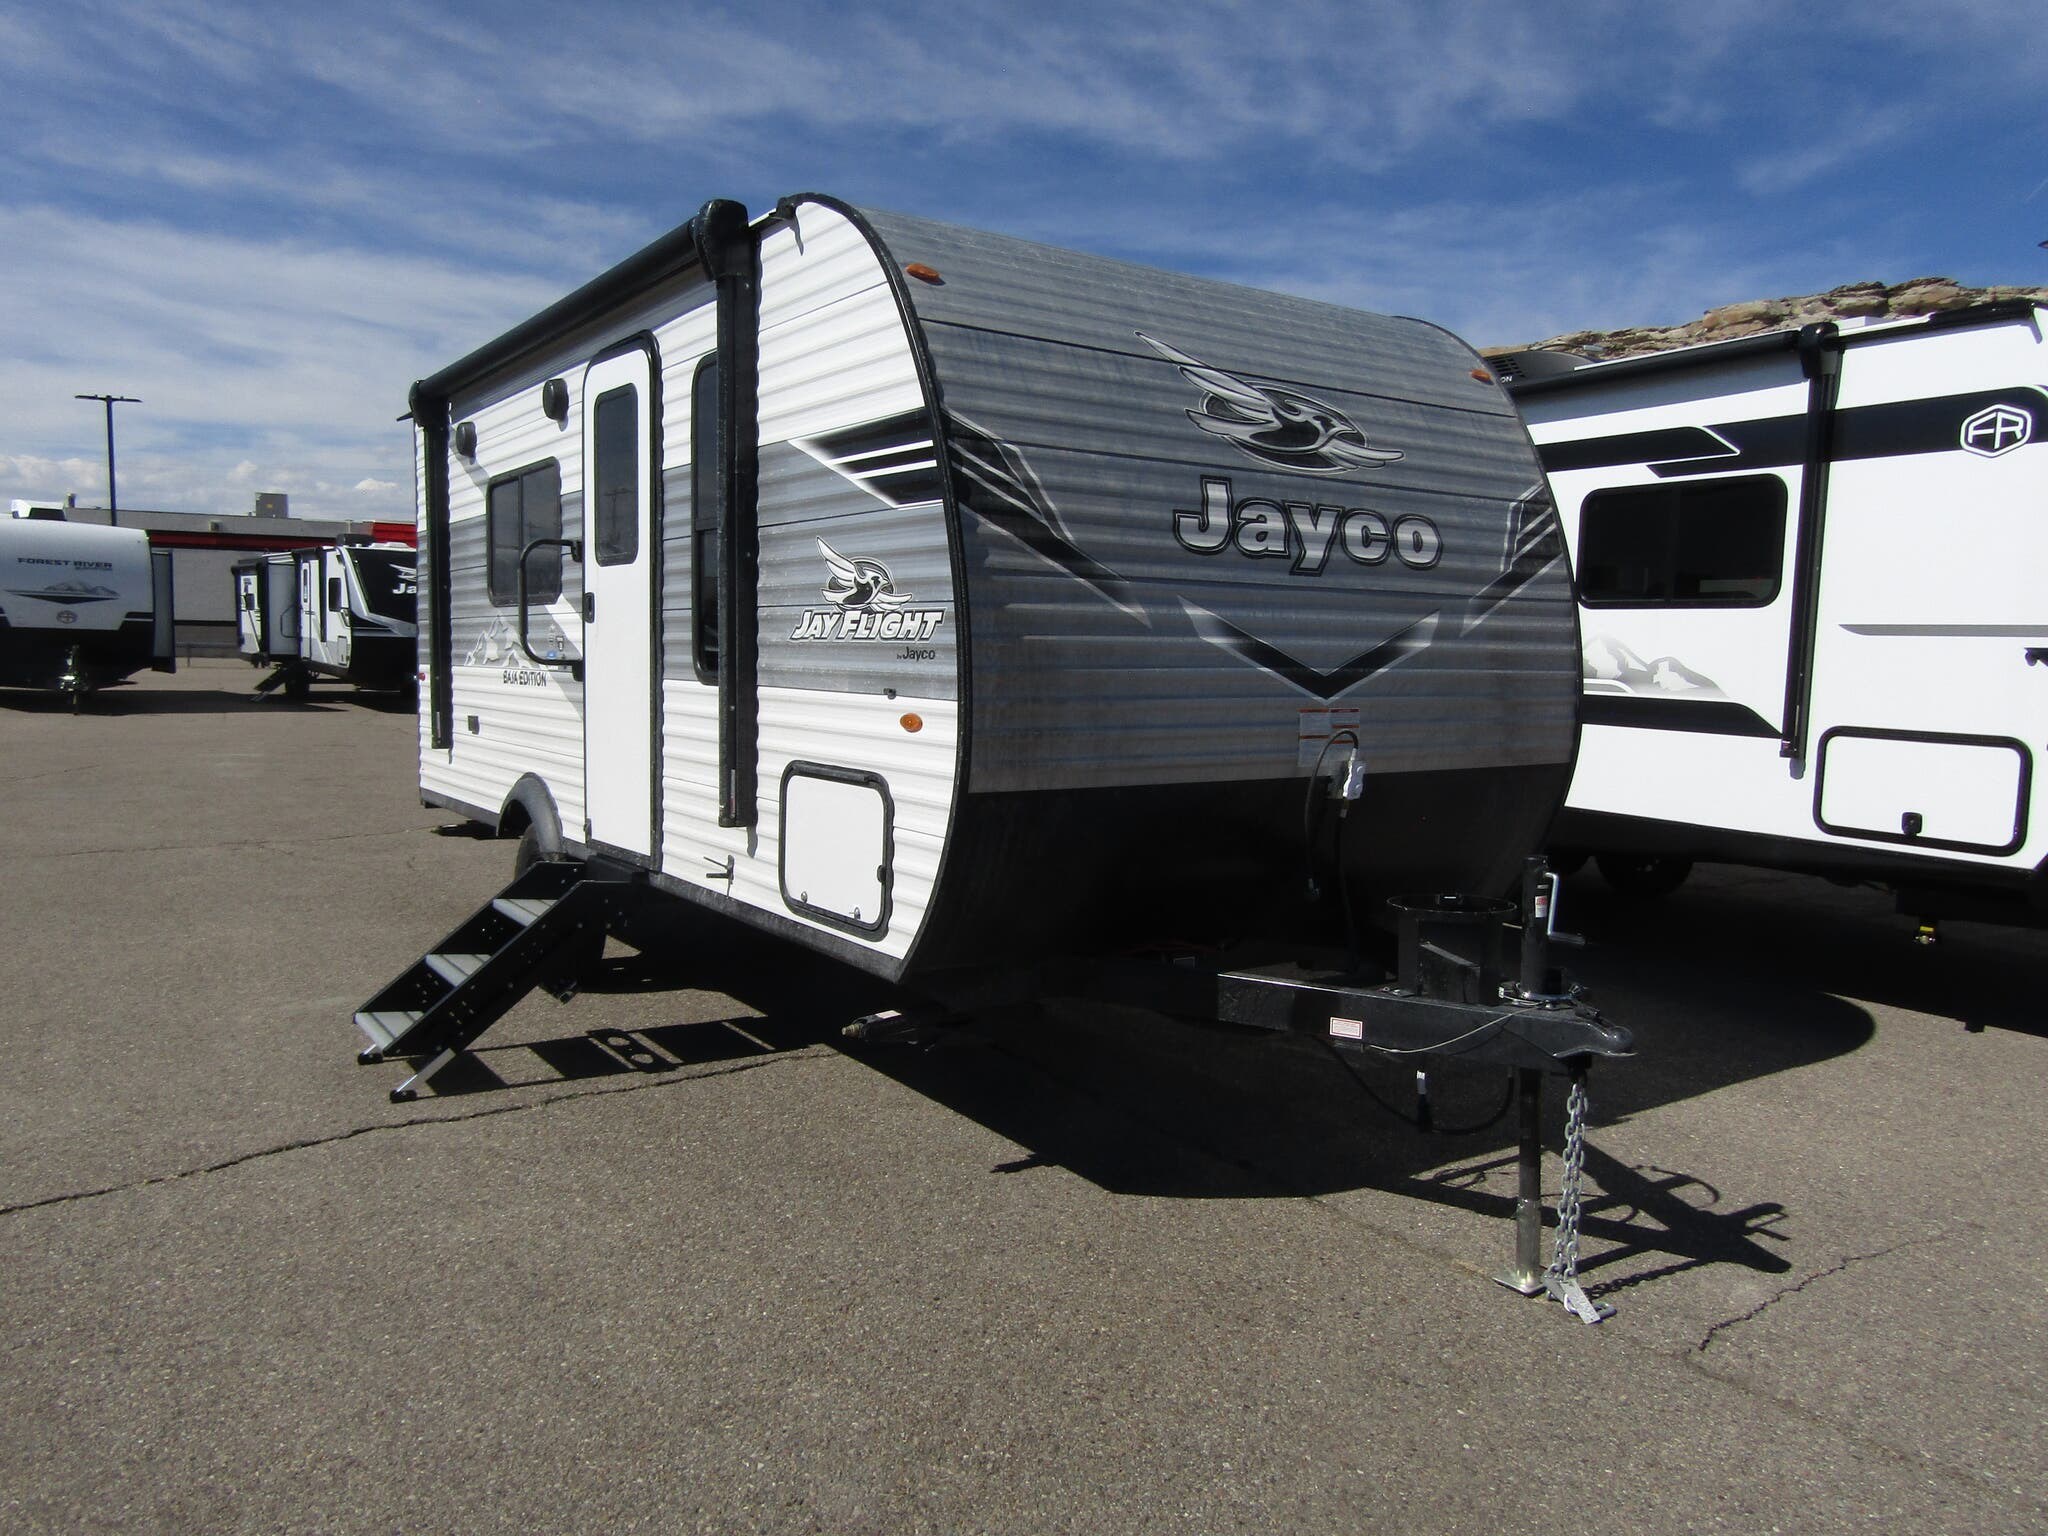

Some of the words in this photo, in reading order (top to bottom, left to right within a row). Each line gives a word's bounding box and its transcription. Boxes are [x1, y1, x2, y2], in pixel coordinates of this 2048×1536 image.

[1173, 475, 1443, 577] Jayco
[17, 558, 71, 566] FOREST
[791, 610, 842, 640] JAY
[837, 610, 945, 641] FLIGHT
[903, 646, 936, 662] Jayco
[503, 670, 518, 685] BAJA
[519, 671, 547, 687] EDITION
